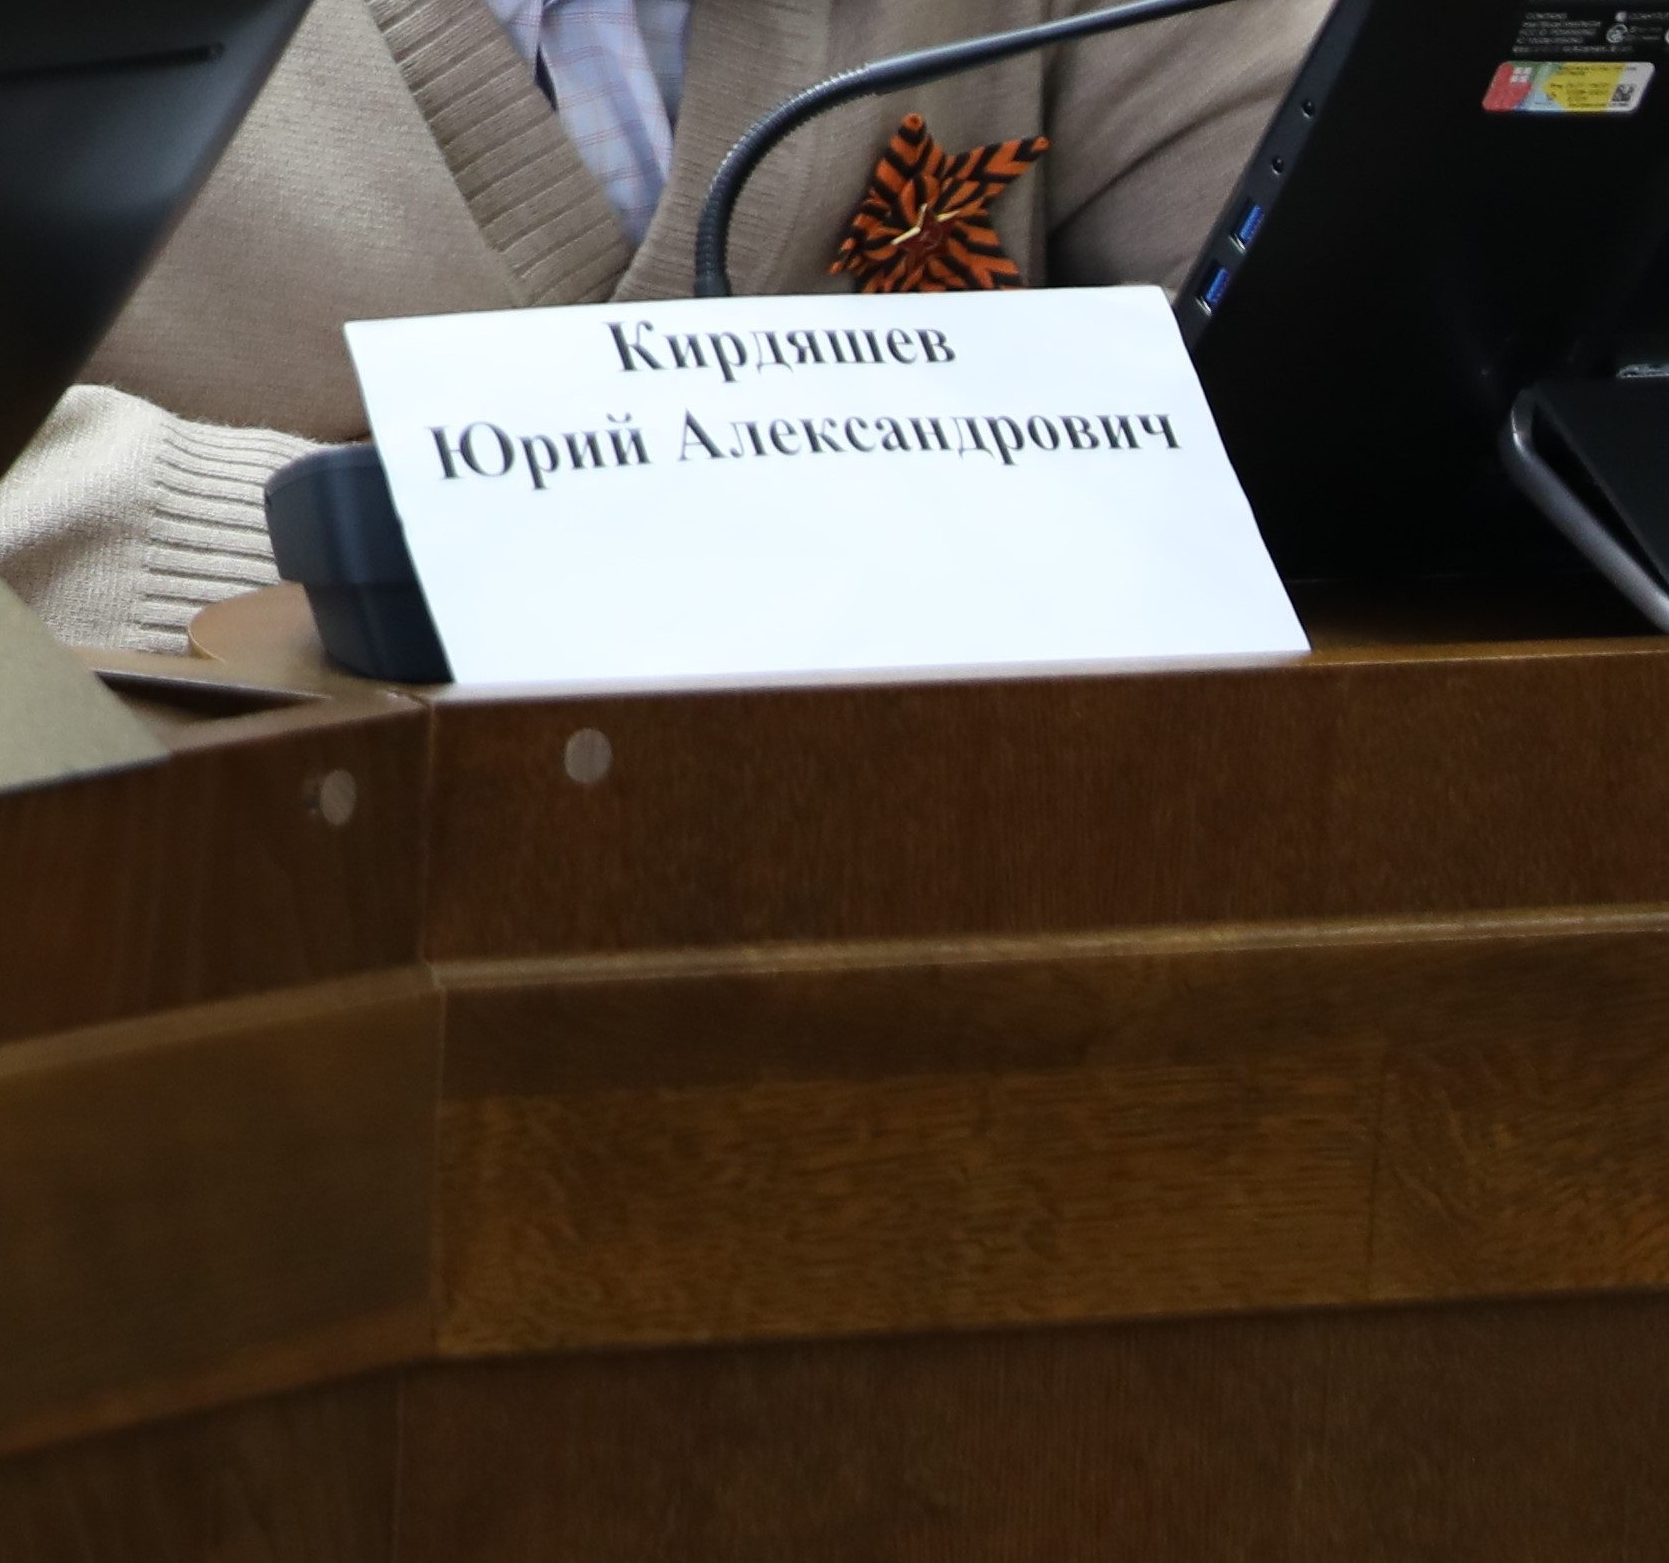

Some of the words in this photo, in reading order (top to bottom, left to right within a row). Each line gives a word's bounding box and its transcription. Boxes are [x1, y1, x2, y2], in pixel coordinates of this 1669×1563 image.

[606, 320, 957, 383] Кирдяшев
[427, 412, 651, 491] Юрий
[677, 409, 1182, 467] Александрович
